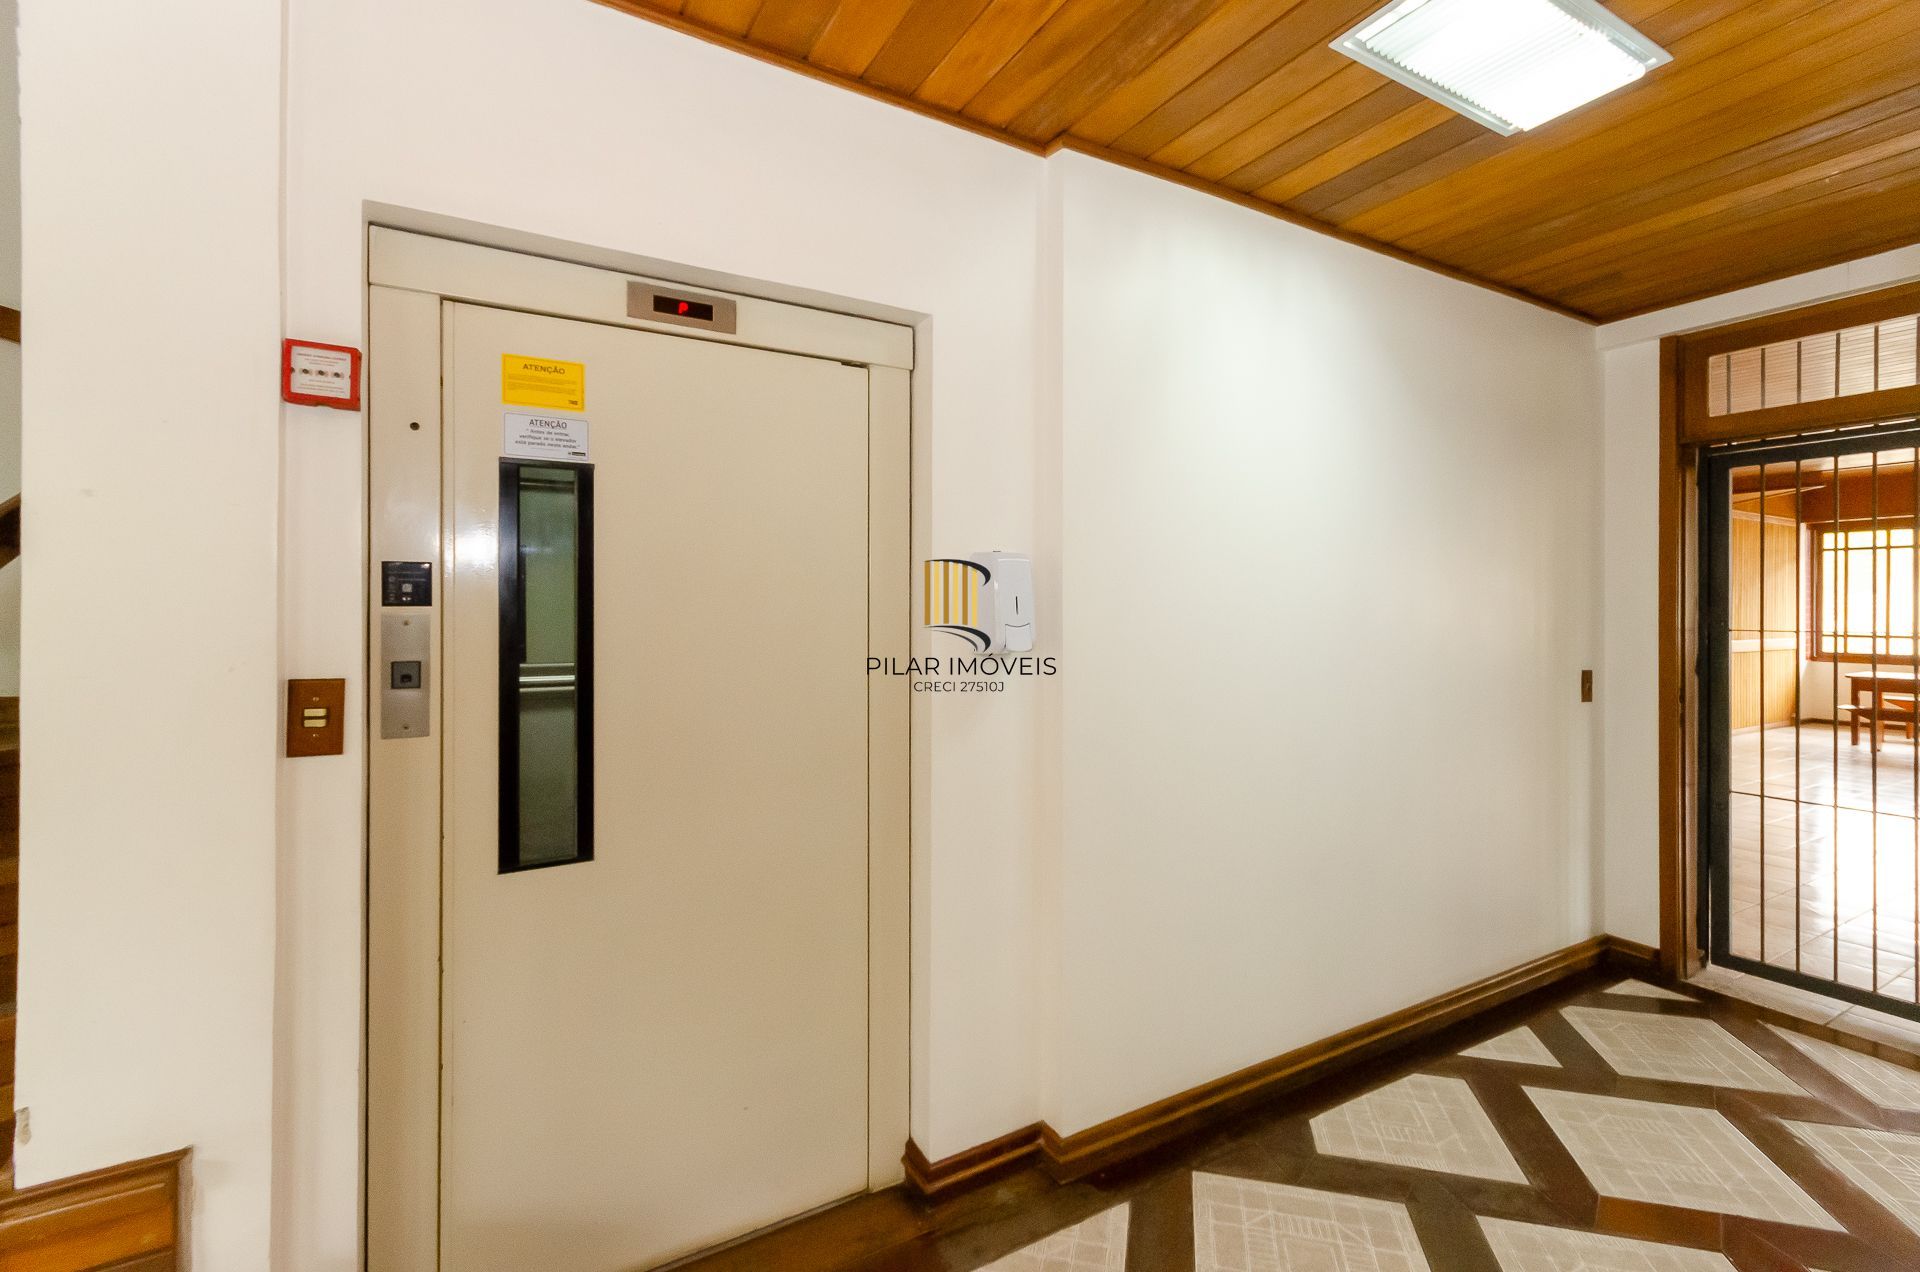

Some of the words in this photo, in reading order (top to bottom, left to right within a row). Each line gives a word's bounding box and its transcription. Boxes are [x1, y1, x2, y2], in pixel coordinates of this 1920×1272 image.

[678, 301, 689, 315] P
[523, 363, 566, 375] ATENÇÃO
[529, 419, 568, 429] ATENÇÃO
